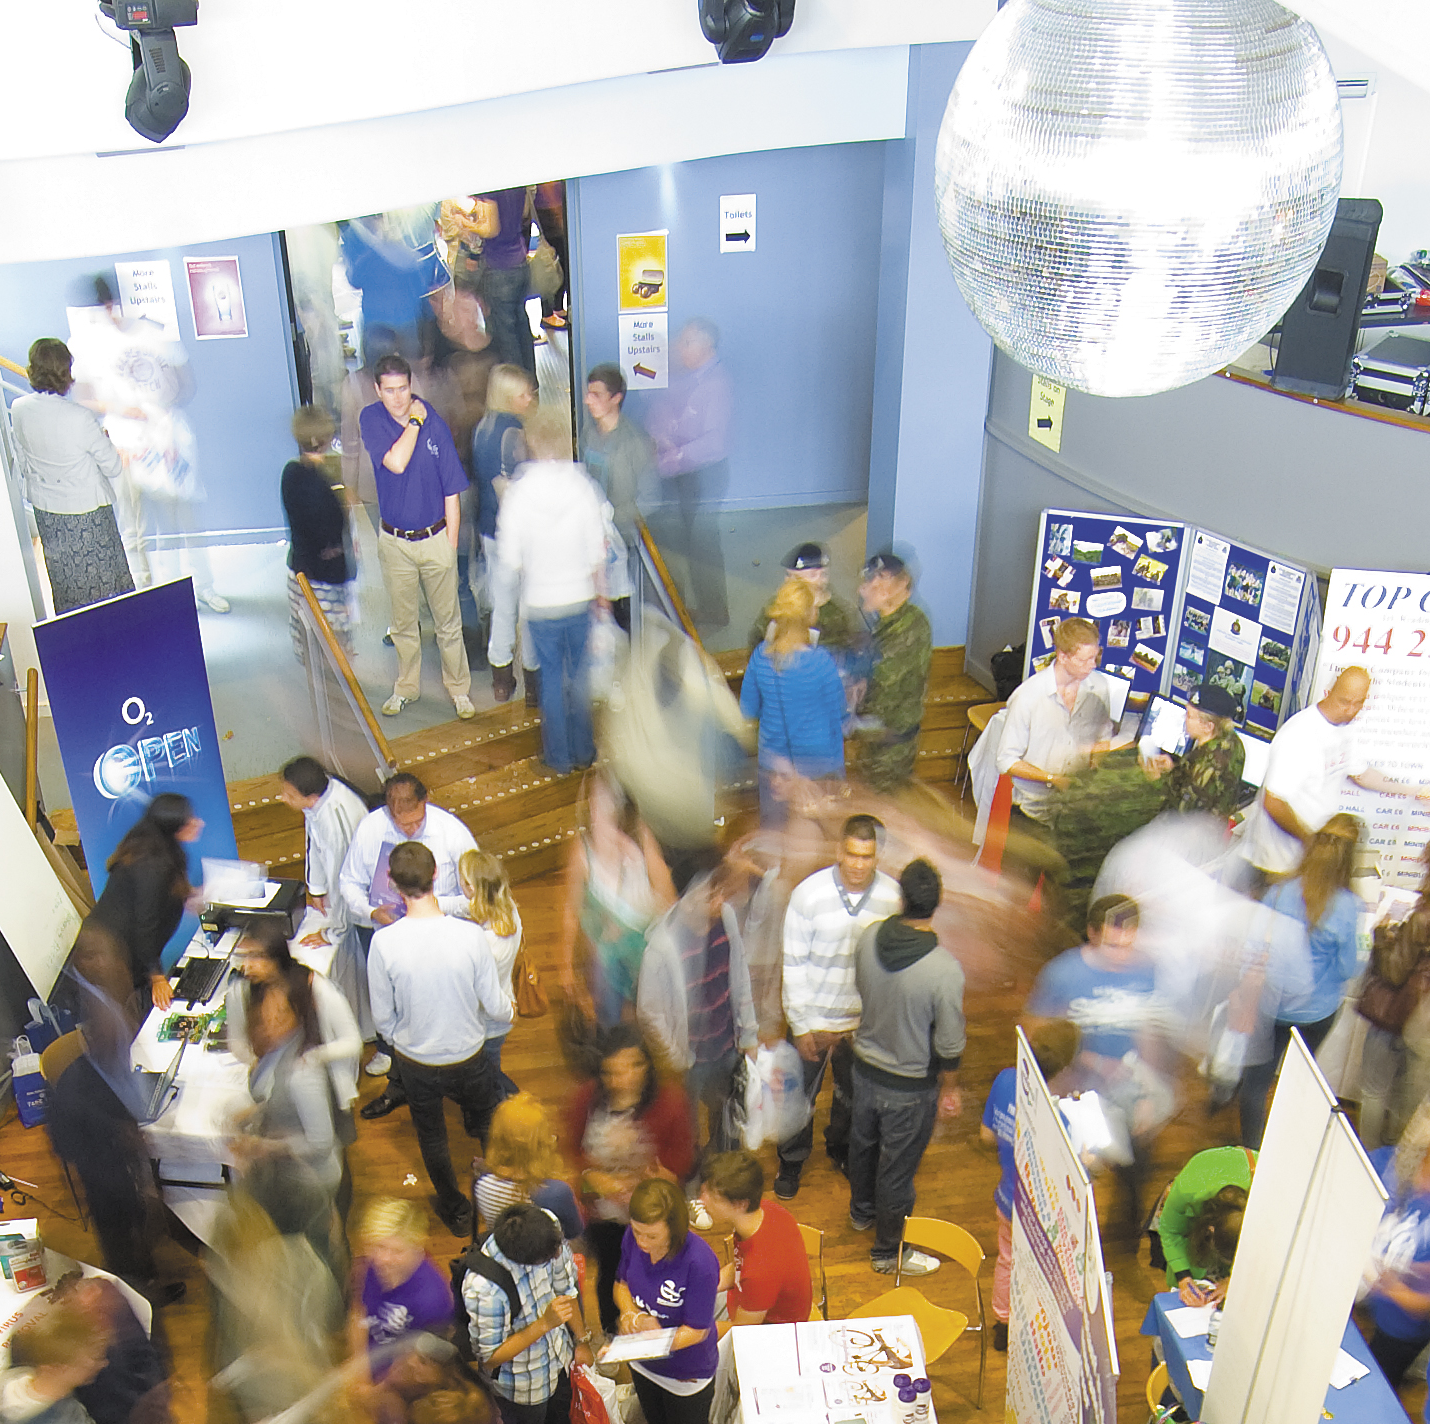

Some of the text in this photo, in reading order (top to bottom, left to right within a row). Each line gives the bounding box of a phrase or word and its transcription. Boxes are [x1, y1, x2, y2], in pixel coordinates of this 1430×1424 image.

[724, 210, 752, 220] Toilets
[132, 269, 155, 278] More
[633, 320, 654, 329] More
[633, 332, 655, 342] Stalls
[627, 345, 661, 355] Upstairs
[1342, 583, 1412, 610] TOP
[1332, 625, 1394, 655] 944
[93, 726, 202, 799] OPEN
[1376, 807, 1393, 815] CAR
[1372, 822, 1390, 830] CAR
[1369, 837, 1386, 846] CAR
